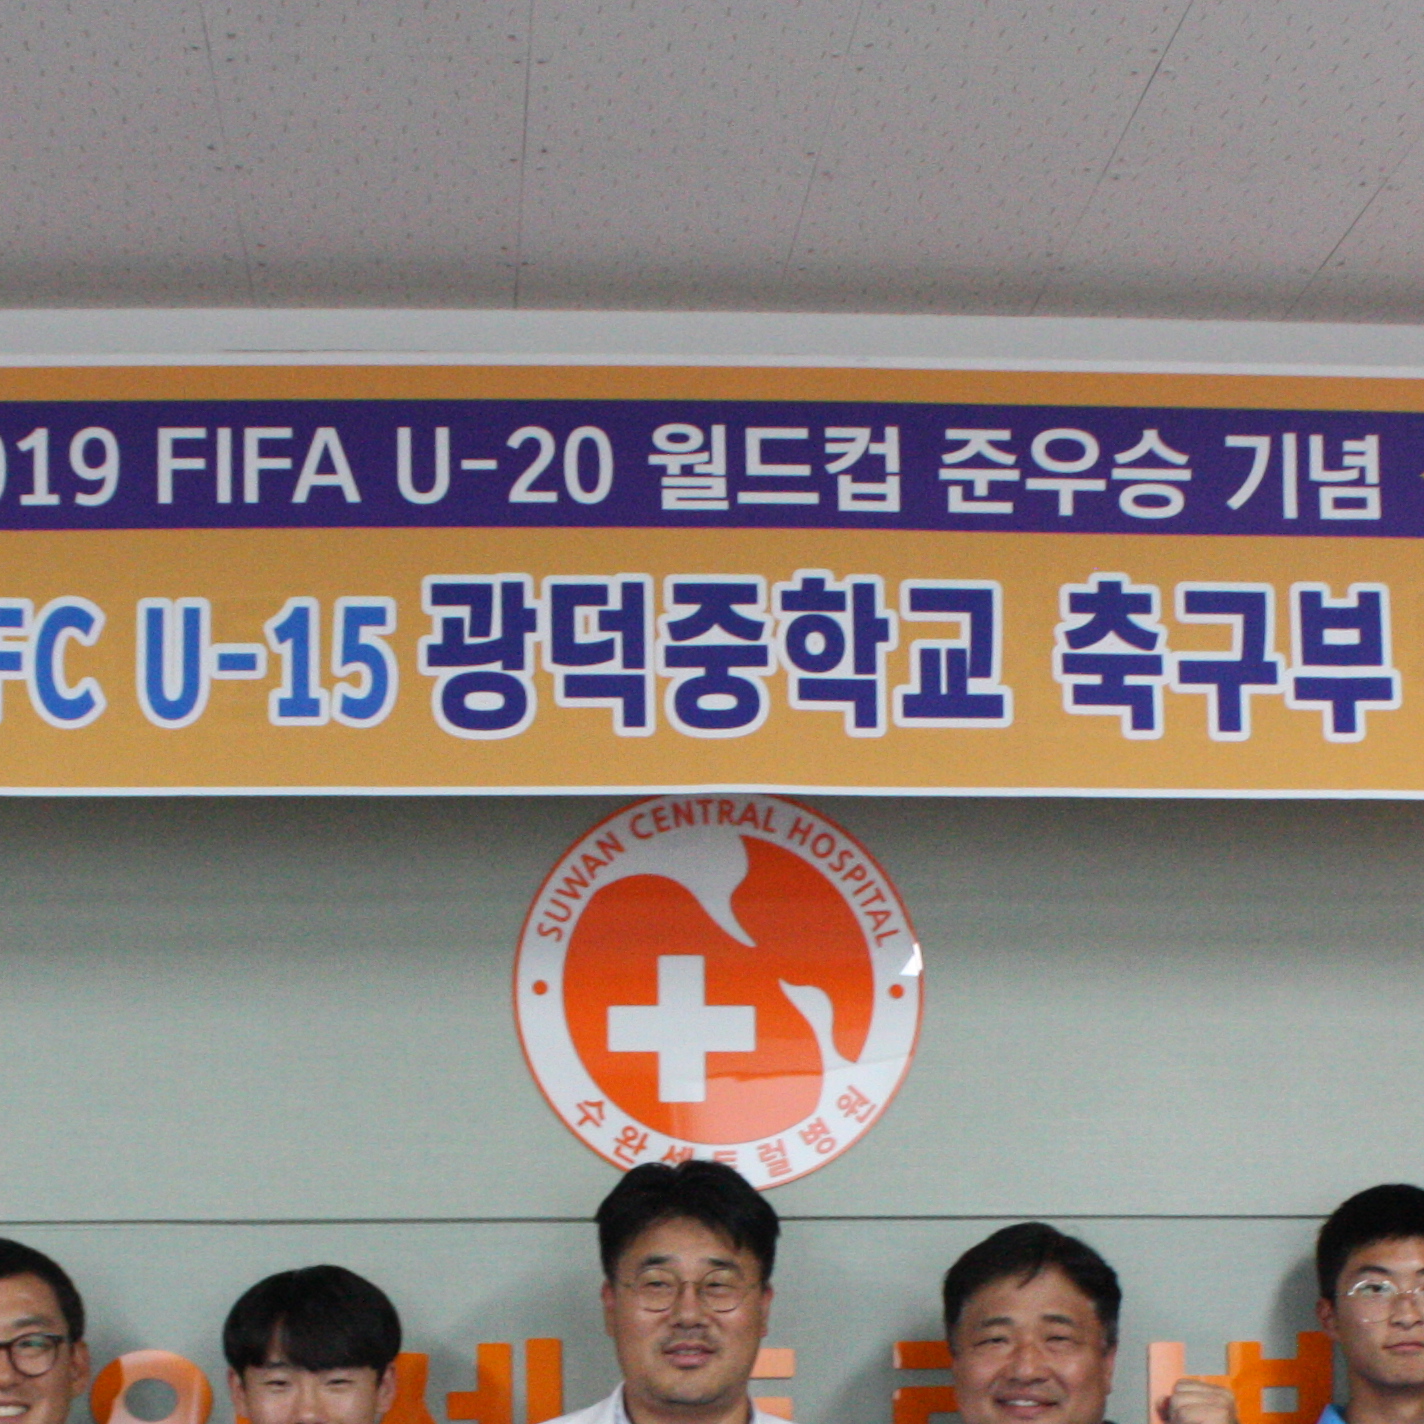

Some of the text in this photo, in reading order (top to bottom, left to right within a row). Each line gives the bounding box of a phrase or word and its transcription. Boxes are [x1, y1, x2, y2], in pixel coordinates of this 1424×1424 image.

[154, 426, 363, 505] FIFA
[394, 425, 615, 507] U-20
[647, 421, 901, 515] 월드컵
[936, 426, 1193, 520] 준우승
[1222, 430, 1384, 522] 기념
[138, 601, 395, 728] U-15
[421, 572, 1016, 735] 광덕중학교
[1057, 576, 1400, 738] 축구부
[536, 798, 902, 948] SUWAN CENTRAL HOSPITAL
